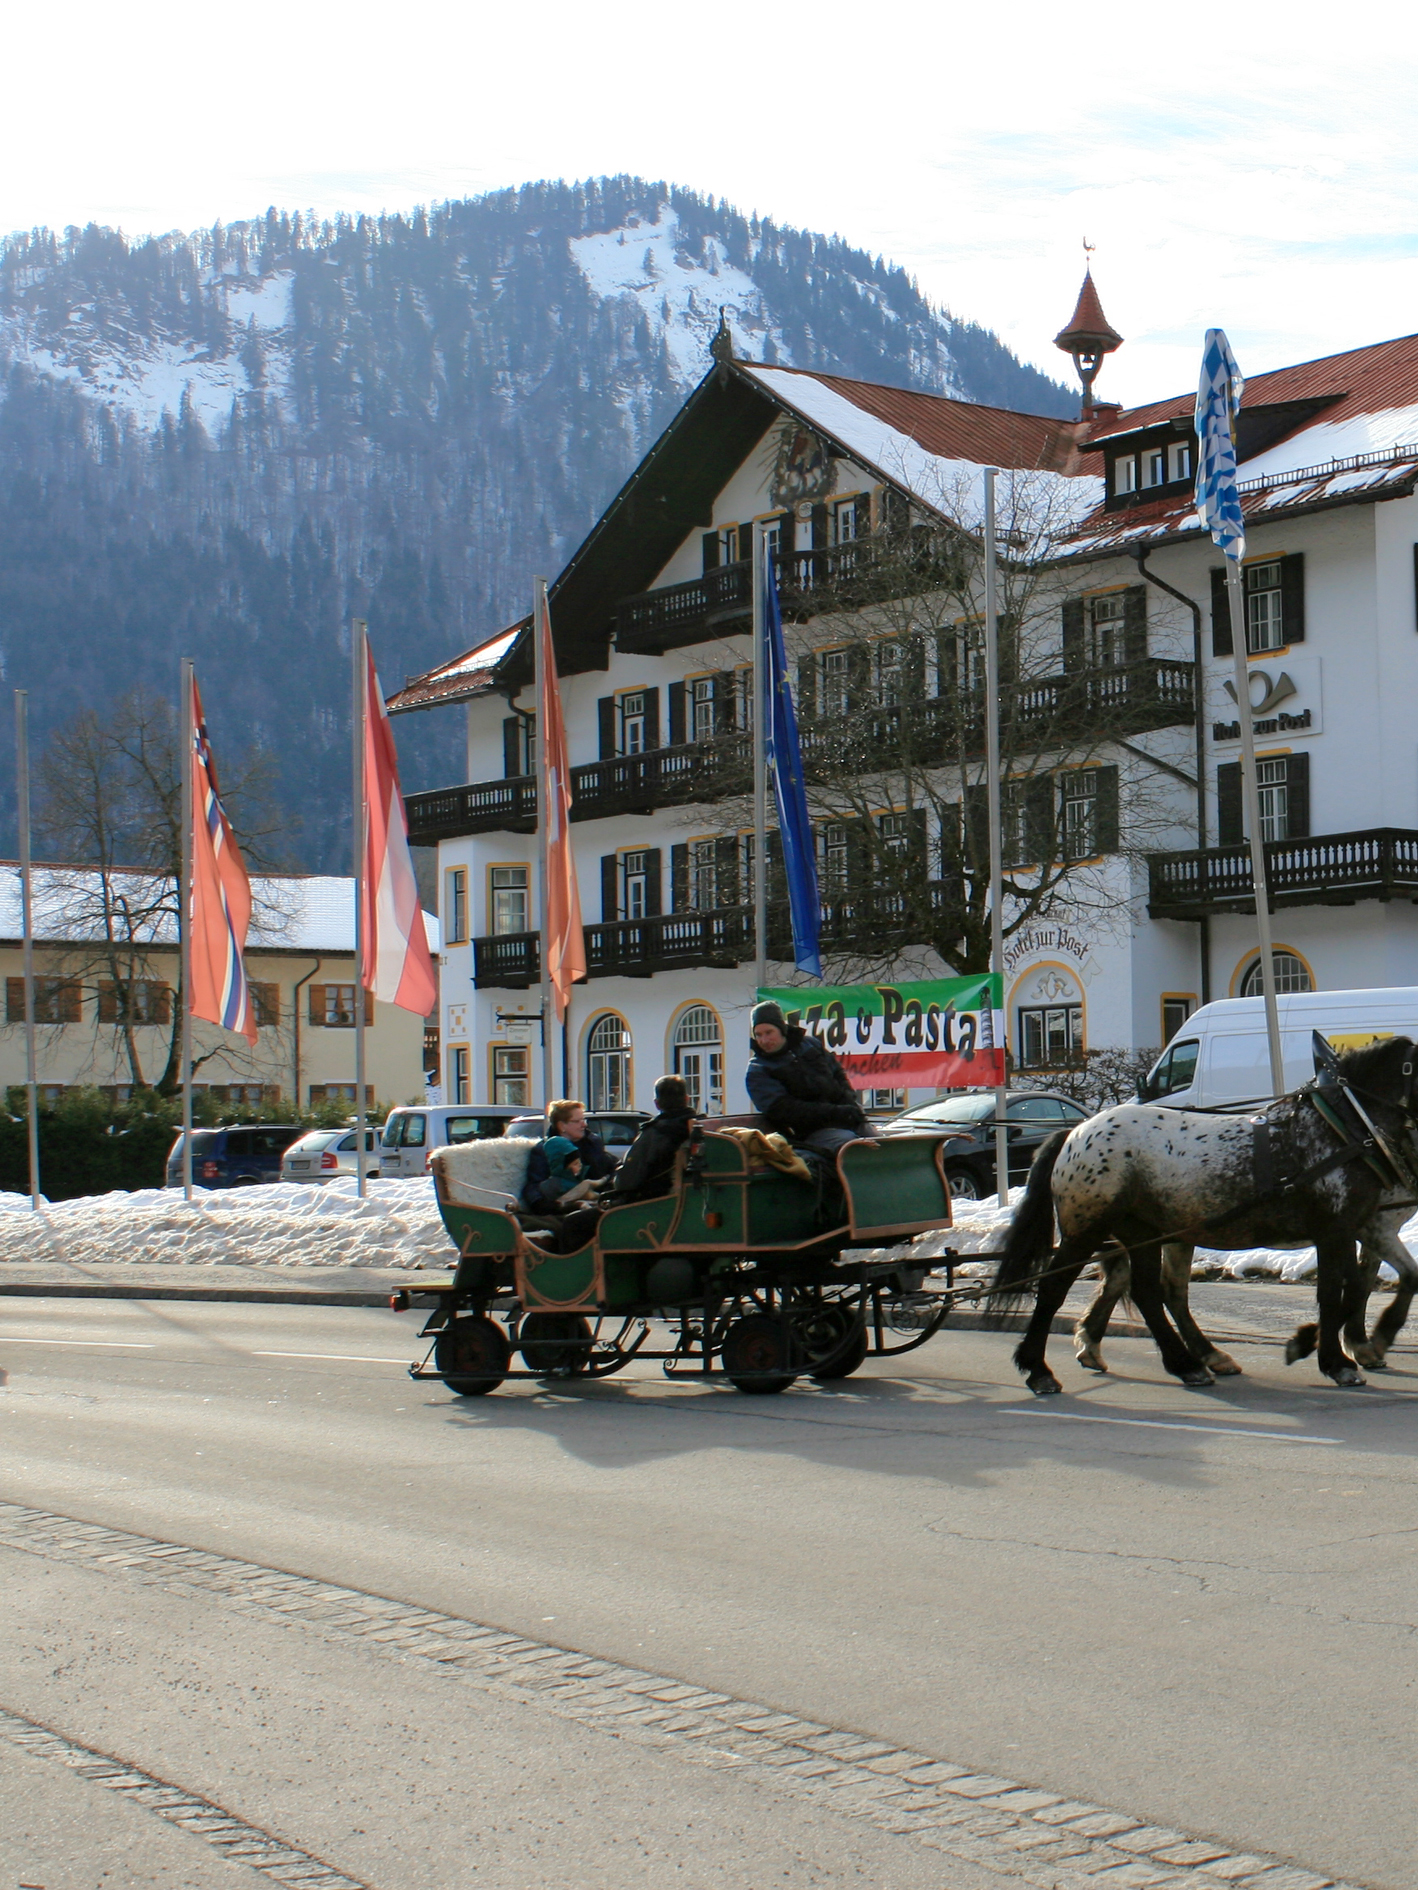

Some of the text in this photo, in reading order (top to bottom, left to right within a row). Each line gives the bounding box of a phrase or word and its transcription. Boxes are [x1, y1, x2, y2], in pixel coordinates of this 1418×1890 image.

[1278, 709, 1311, 731] Post
[1057, 927, 1089, 960] Post
[856, 1006, 873, 1044] &
[875, 987, 977, 1062] Pasta
